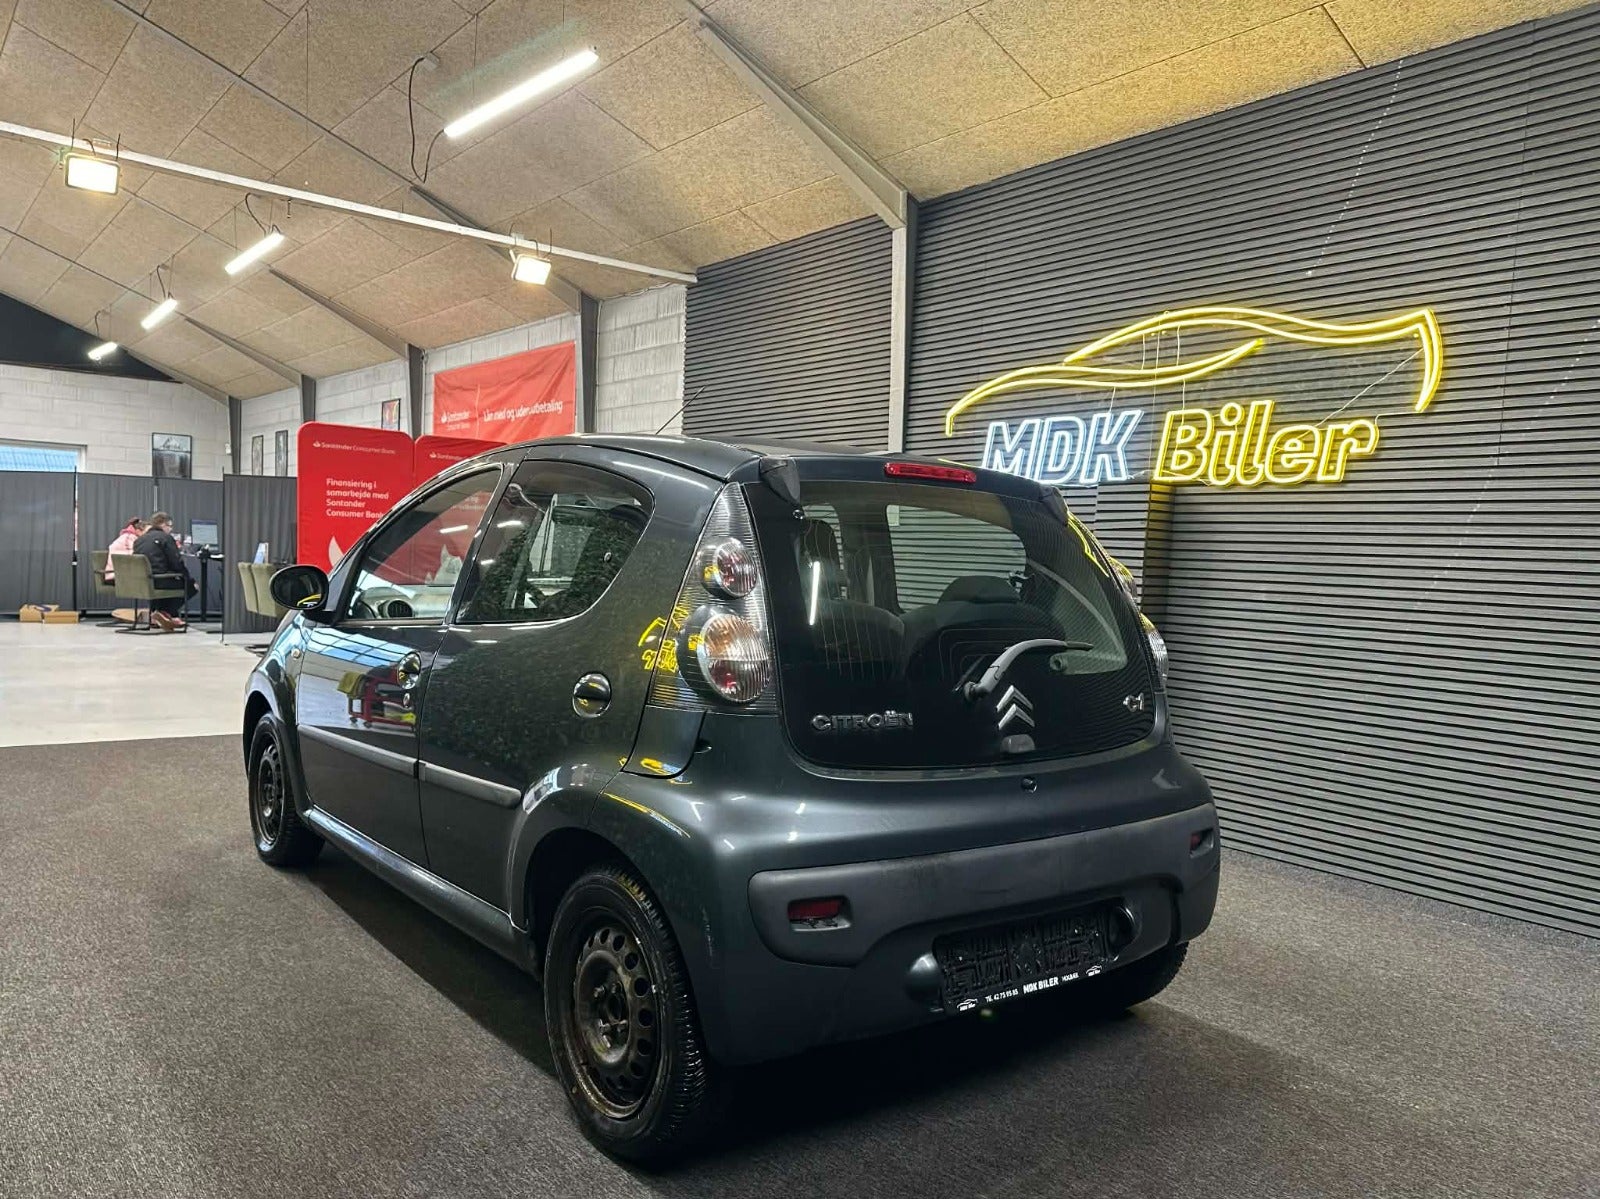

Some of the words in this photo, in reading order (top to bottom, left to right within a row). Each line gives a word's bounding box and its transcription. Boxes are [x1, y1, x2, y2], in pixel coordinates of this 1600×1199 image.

[982, 409, 1144, 485] MDK
[1153, 399, 1379, 486] Biler
[326, 478, 373, 490] Finansiering
[326, 490, 371, 499] samarbejde
[372, 491, 389, 500] med
[326, 499, 366, 508] Santander
[326, 509, 364, 518] Consumer
[812, 710, 914, 730] CITROËN
[1038, 977, 1059, 990] BILER
